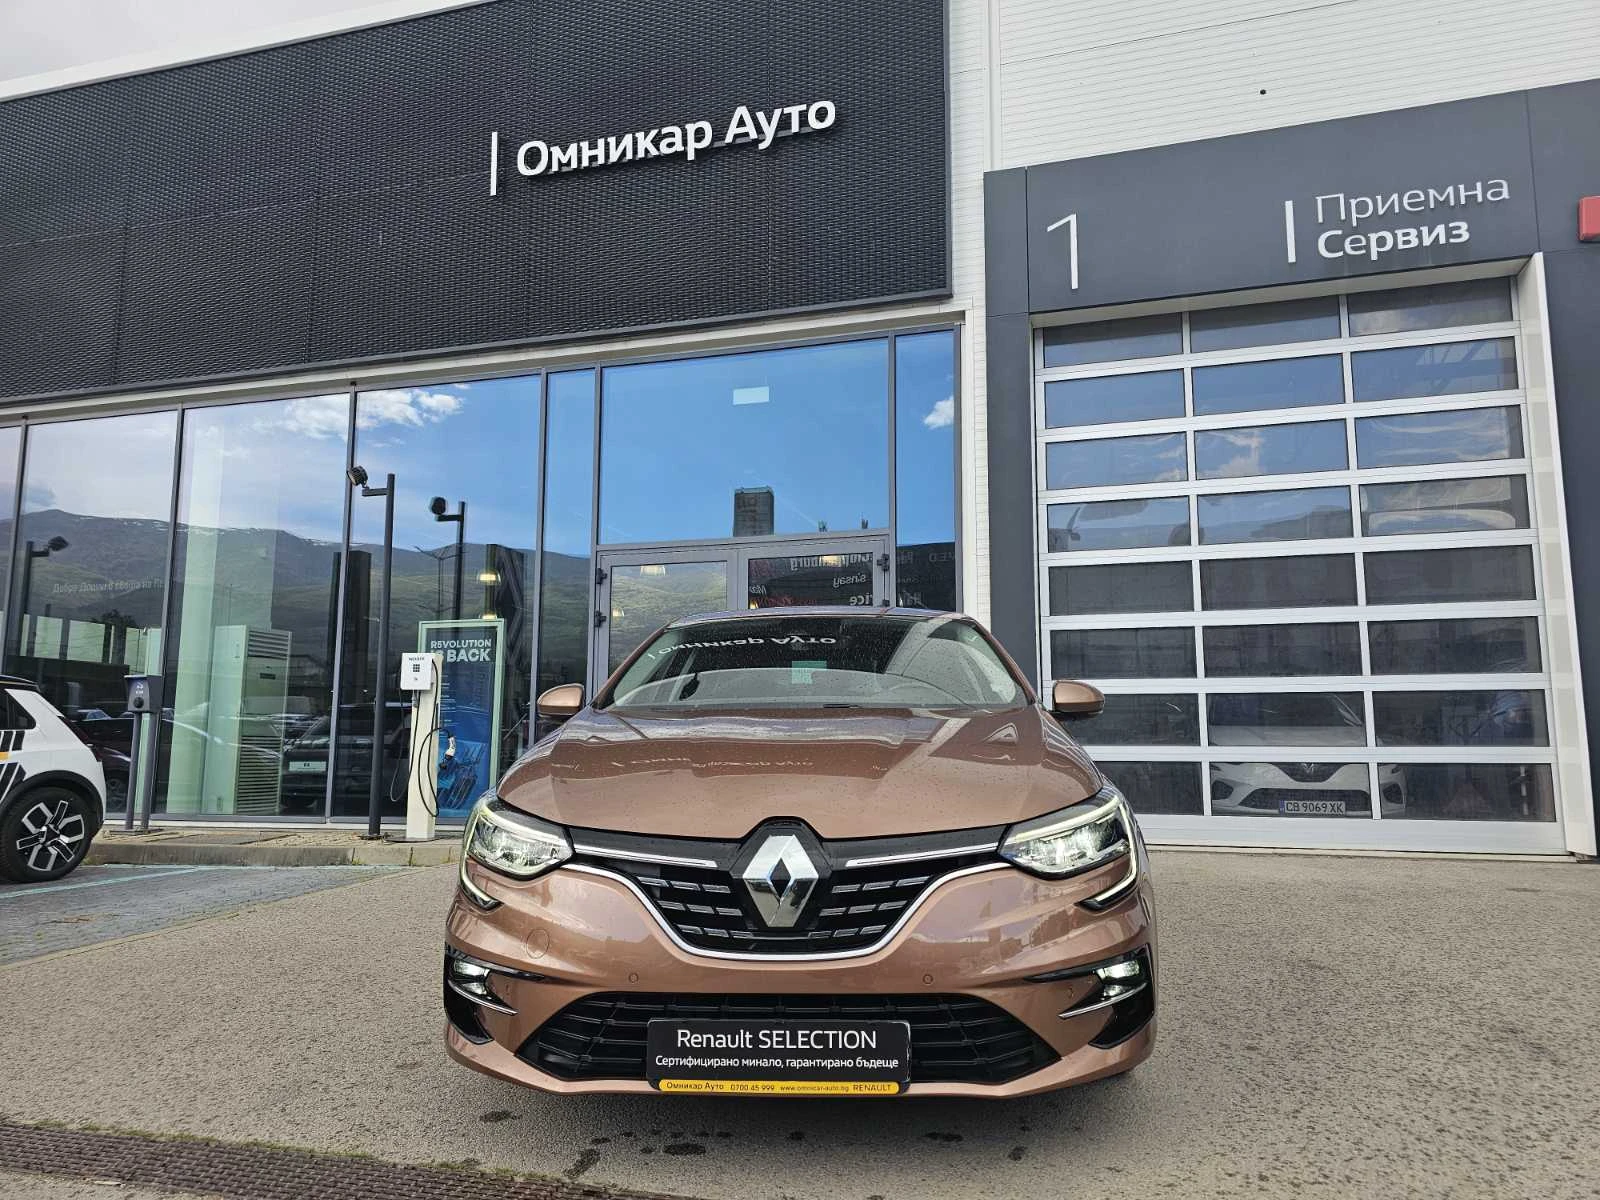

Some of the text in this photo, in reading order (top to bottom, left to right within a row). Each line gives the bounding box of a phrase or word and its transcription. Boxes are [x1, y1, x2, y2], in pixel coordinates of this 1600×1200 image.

[516, 100, 836, 176] Омникар Ауто
[1315, 178, 1511, 227] Приемна
[1316, 219, 1471, 261] Сервиз
[1046, 213, 1079, 290] 1
[446, 648, 492, 663] BACK
[1286, 802, 1344, 814] CB 9069 XK
[677, 1029, 877, 1049] Renault SELECTION
[655, 1055, 899, 1070] Сертифицирано минало, гарантирано бъдеще
[666, 1081, 703, 1090] Омникар
[705, 1082, 724, 1093] Ауто
[730, 1083, 749, 1092] 0700
[750, 1084, 760, 1092] 45
[852, 1083, 892, 1093] RENAULT
